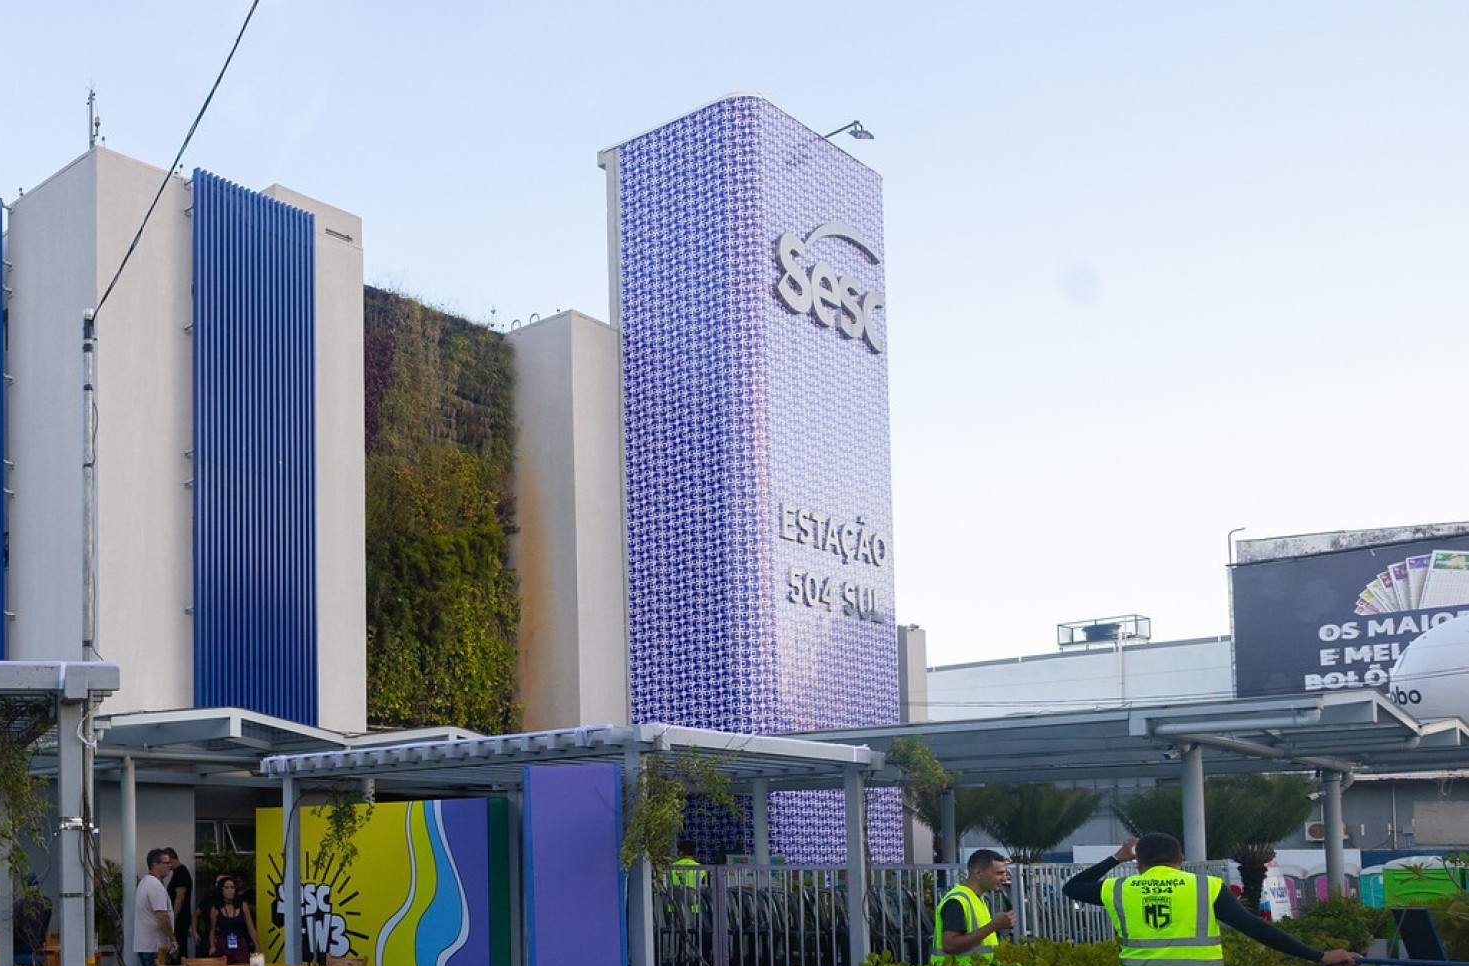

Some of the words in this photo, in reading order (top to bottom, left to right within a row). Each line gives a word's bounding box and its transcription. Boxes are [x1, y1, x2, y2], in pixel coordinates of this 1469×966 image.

[779, 503, 886, 567] ESTAÇÃO
[787, 566, 833, 612] 504
[843, 580, 885, 624] SUL
[1318, 621, 1361, 642] OS
[1367, 610, 1469, 638] MAIO
[1319, 648, 1340, 666] E
[277, 883, 331, 914] SSC
[1131, 879, 1186, 887] SEGURANÇA
